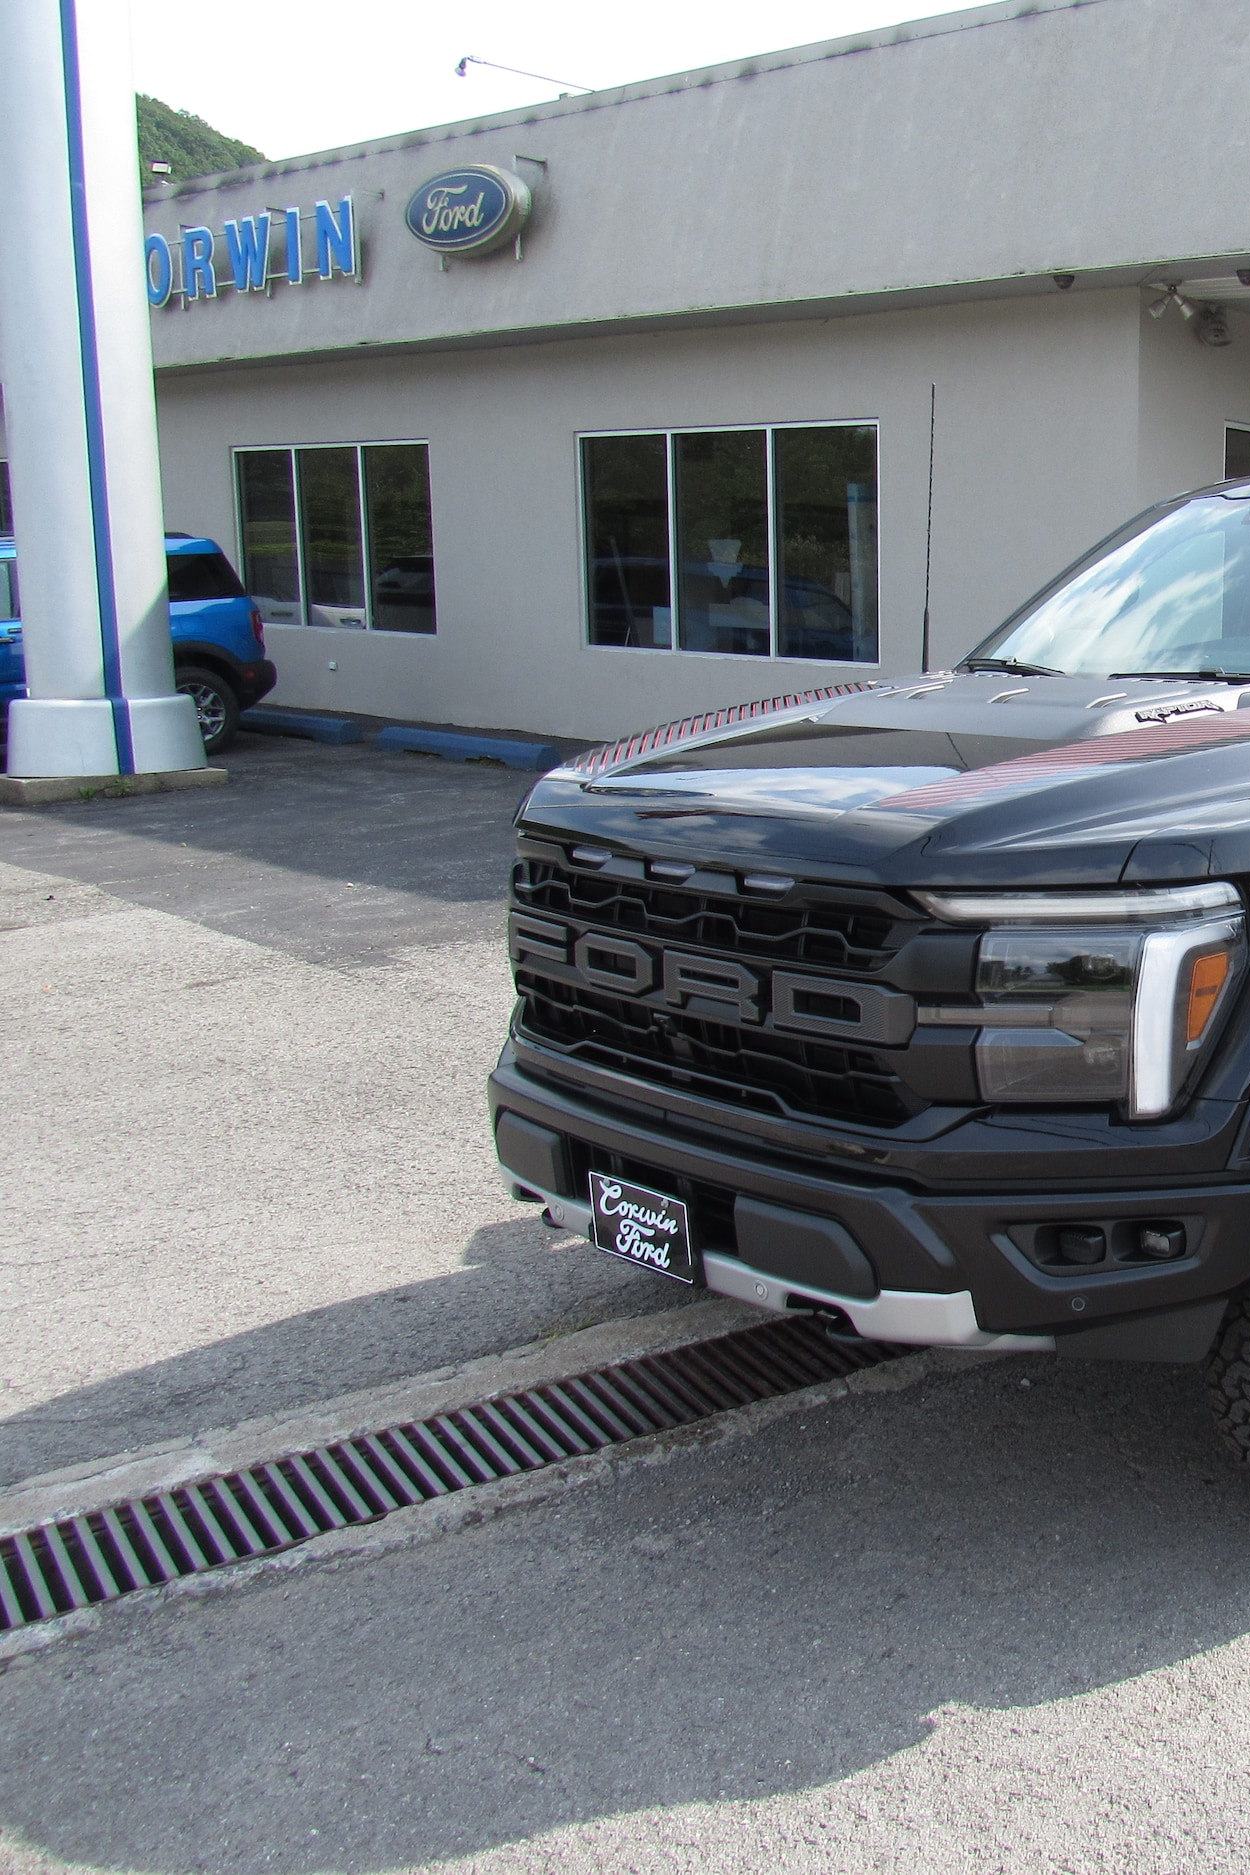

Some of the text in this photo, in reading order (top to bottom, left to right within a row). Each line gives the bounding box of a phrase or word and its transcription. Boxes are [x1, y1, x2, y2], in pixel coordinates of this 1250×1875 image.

[421, 184, 486, 234] Ford
[1135, 699, 1224, 723] RAPTOR
[509, 910, 917, 1045] FORD
[599, 1180, 678, 1234] Corwin
[616, 1218, 671, 1268] Ford
